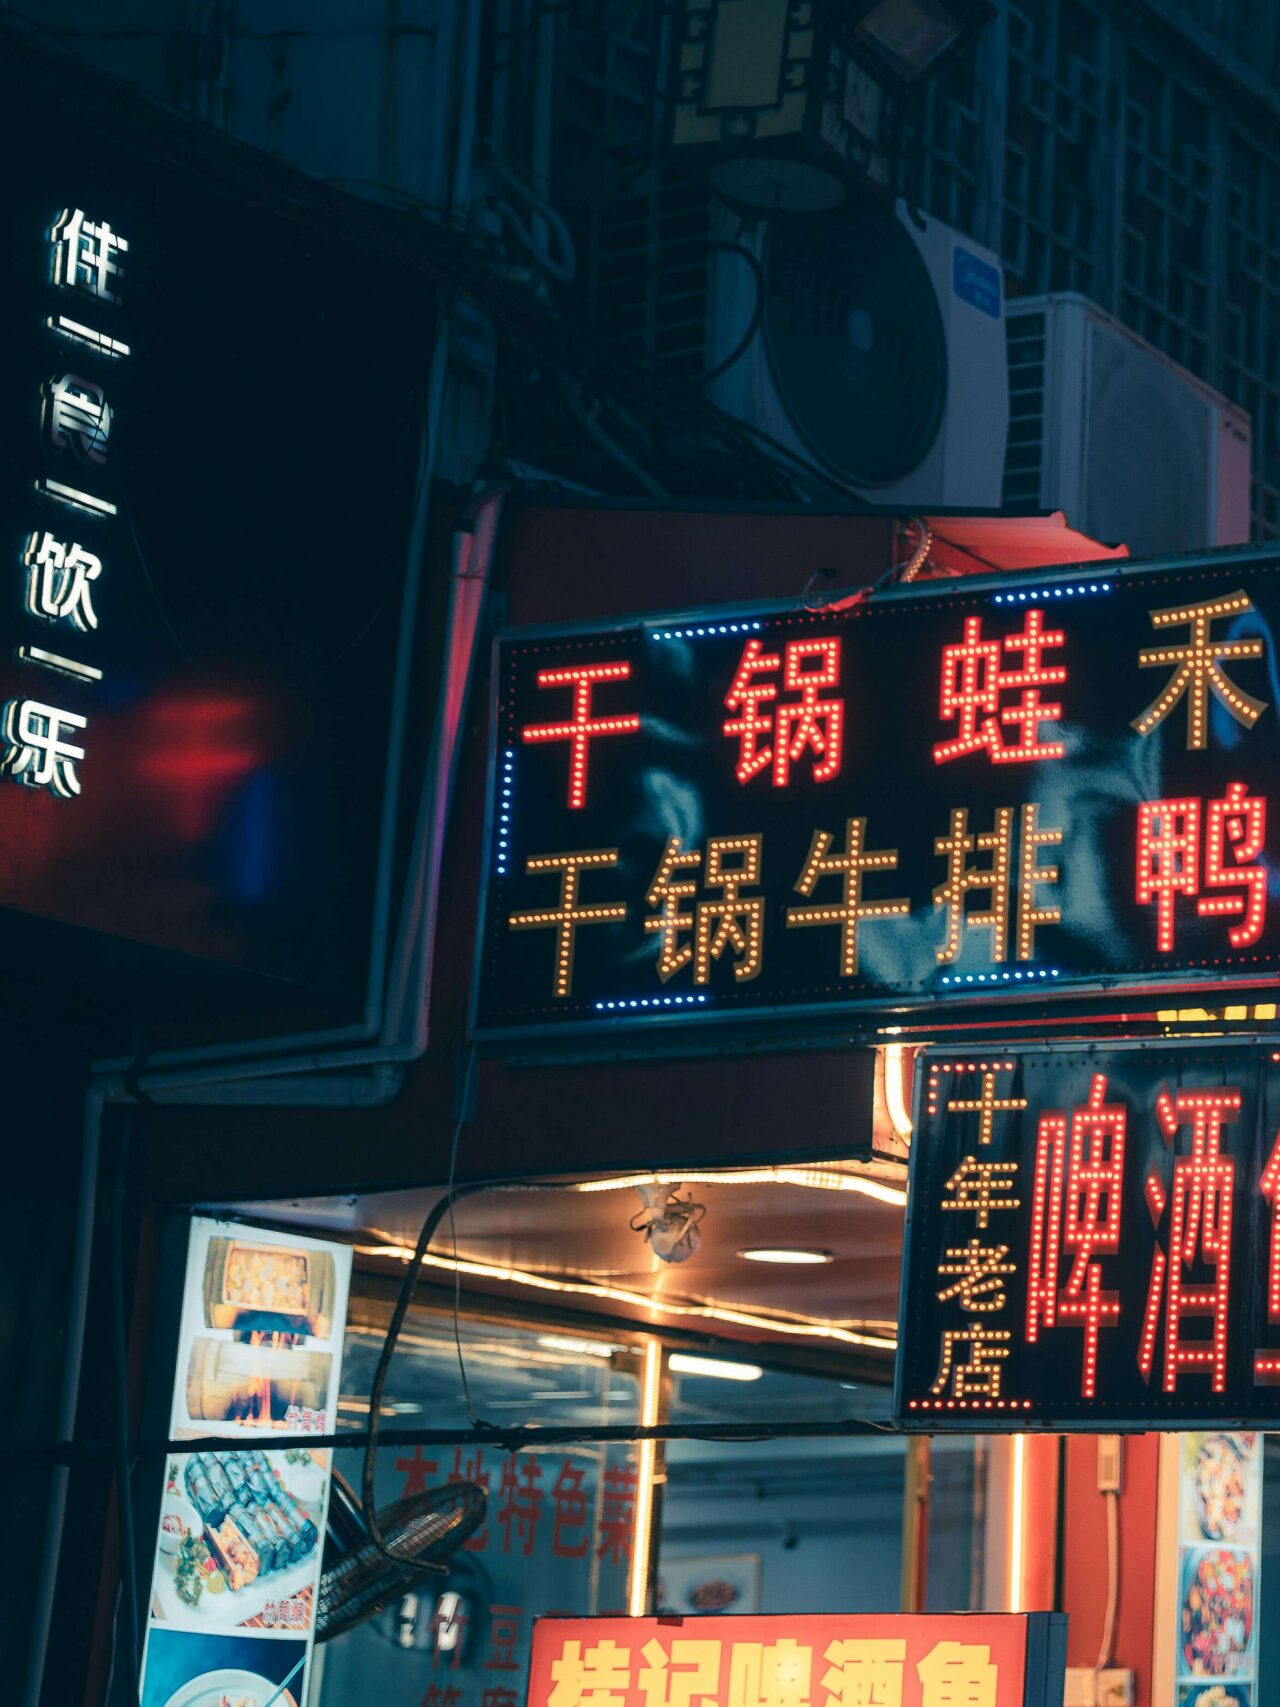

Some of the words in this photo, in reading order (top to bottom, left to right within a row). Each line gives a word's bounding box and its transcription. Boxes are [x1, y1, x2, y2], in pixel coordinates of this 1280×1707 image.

[509, 803, 1063, 997] 干锅牛排
[929, 1073, 1028, 1397] 十年老店
